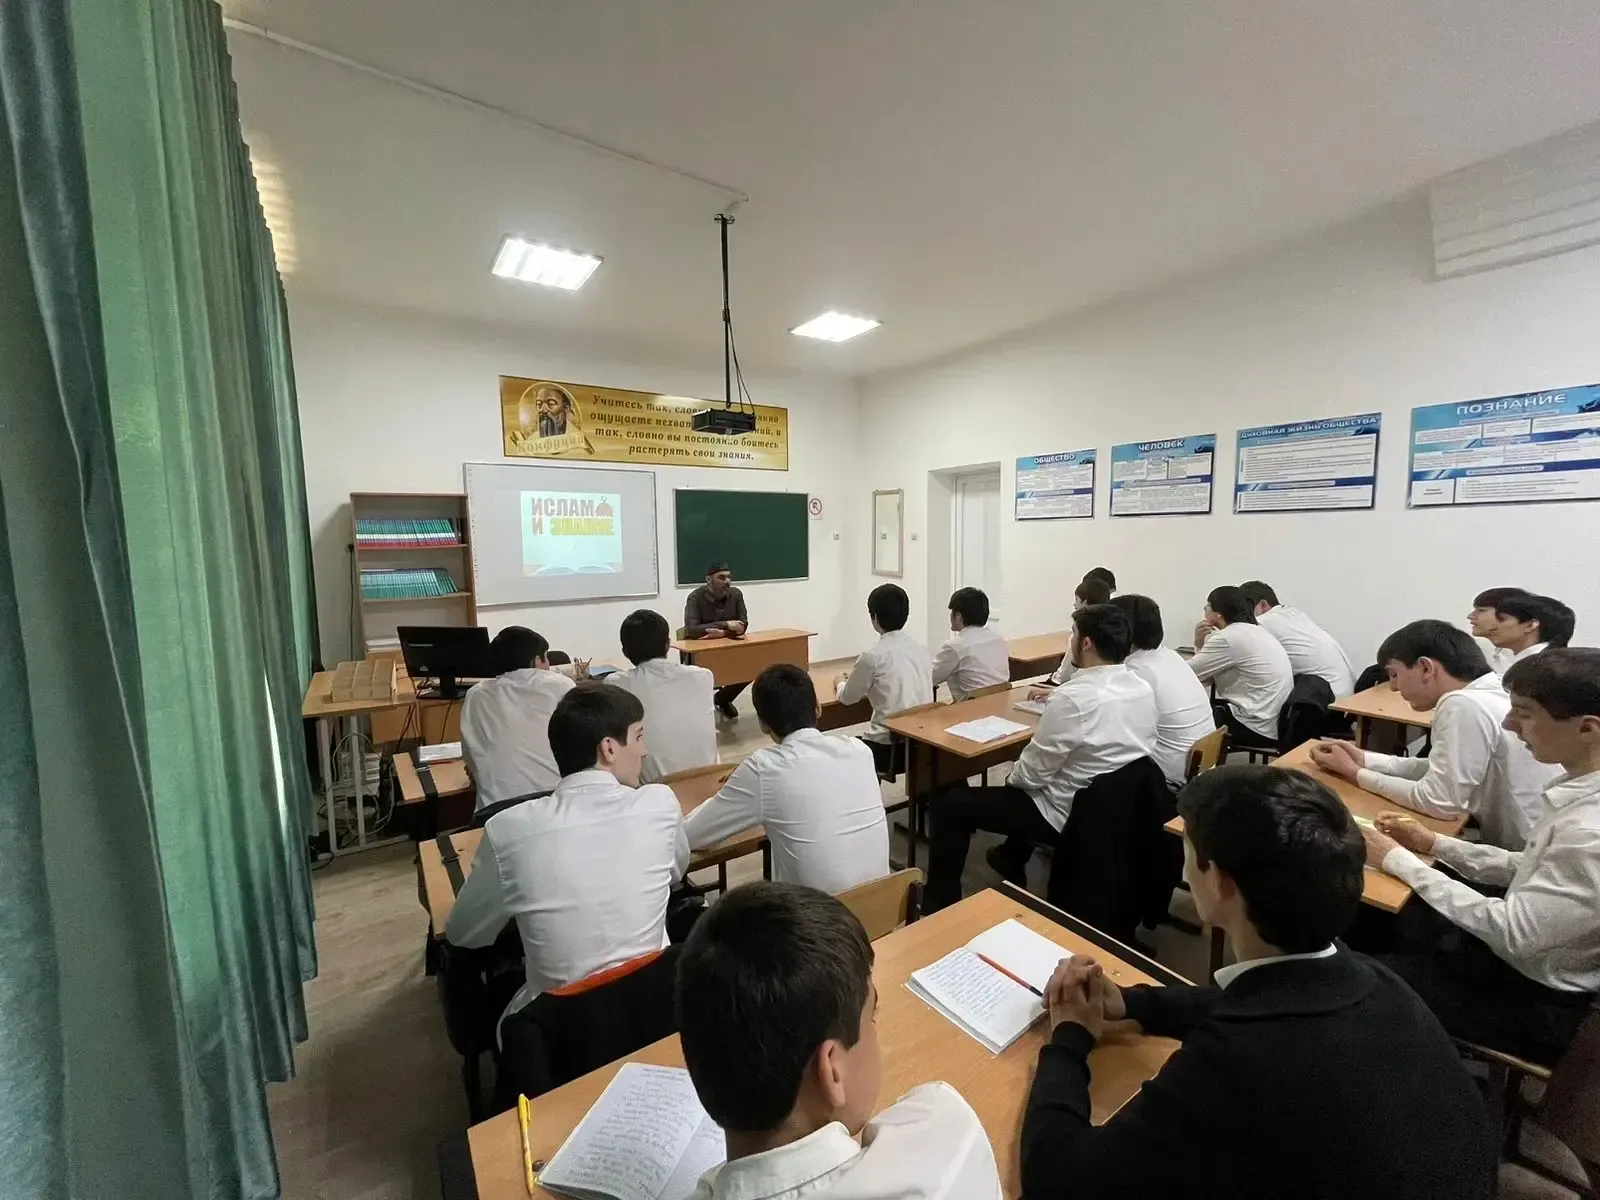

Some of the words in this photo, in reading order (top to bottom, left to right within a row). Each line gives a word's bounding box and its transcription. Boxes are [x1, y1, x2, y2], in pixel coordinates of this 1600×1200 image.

[593, 394, 643, 409] Учитесь
[646, 403, 672, 413] так,
[1456, 393, 1568, 415] ПОЗНАНИЕ
[590, 412, 652, 425] ощущаете
[1240, 428, 1286, 440] ДУХОВНАЯ
[1287, 423, 1321, 434] ЖИЗНЬ
[1322, 416, 1377, 429] ОБЩЕСТВА
[595, 427, 622, 439] так,
[626, 430, 664, 441] словно
[667, 433, 681, 442] вы
[741, 437, 779, 448] боитесь
[1138, 439, 1184, 451] ЧЕЛОВЕК
[629, 445, 690, 457] растерять
[693, 449, 715, 458] свои
[718, 451, 754, 460] знания.
[1033, 453, 1075, 464] ОБЩЕСТВО
[531, 496, 594, 517] ИСЛАМ
[532, 517, 544, 535] И
